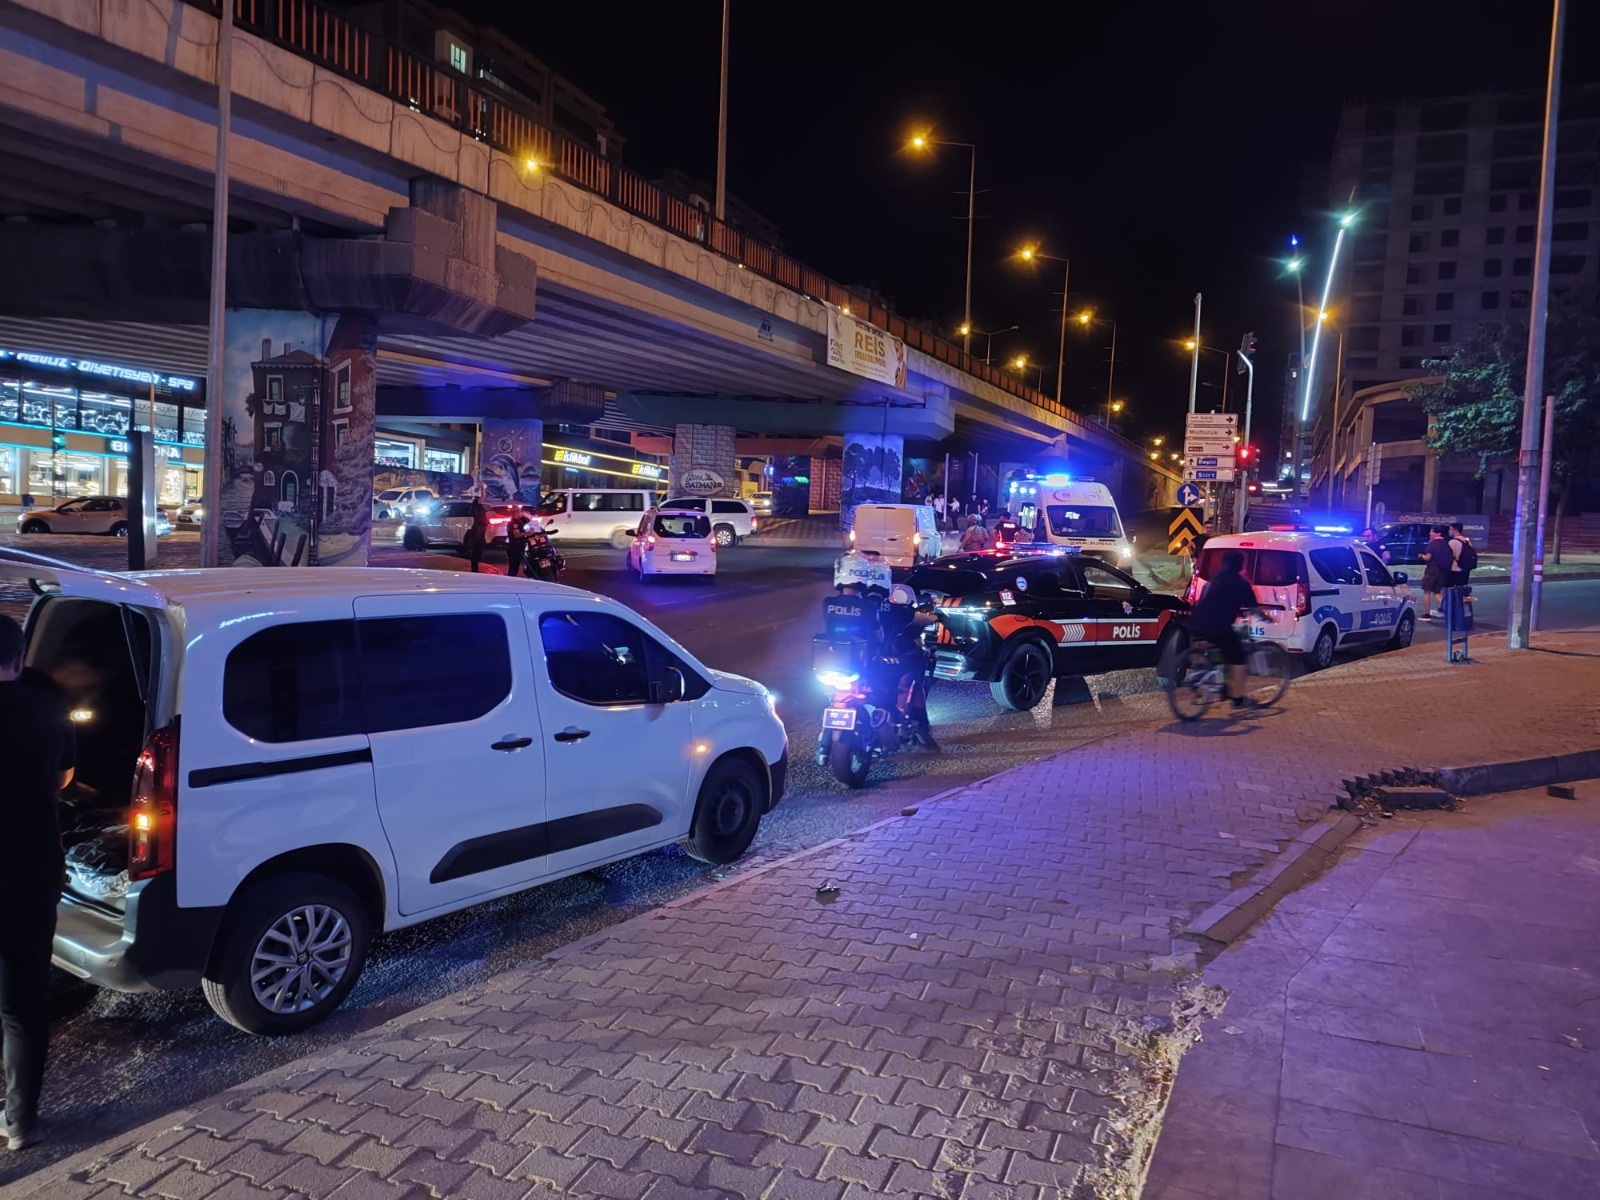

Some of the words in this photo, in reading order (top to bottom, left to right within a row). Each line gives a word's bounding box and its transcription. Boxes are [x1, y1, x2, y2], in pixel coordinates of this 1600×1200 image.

[1001, 592, 1013, 600] 112
[827, 604, 862, 617] POLİS
[1112, 623, 1141, 638] POLİS
